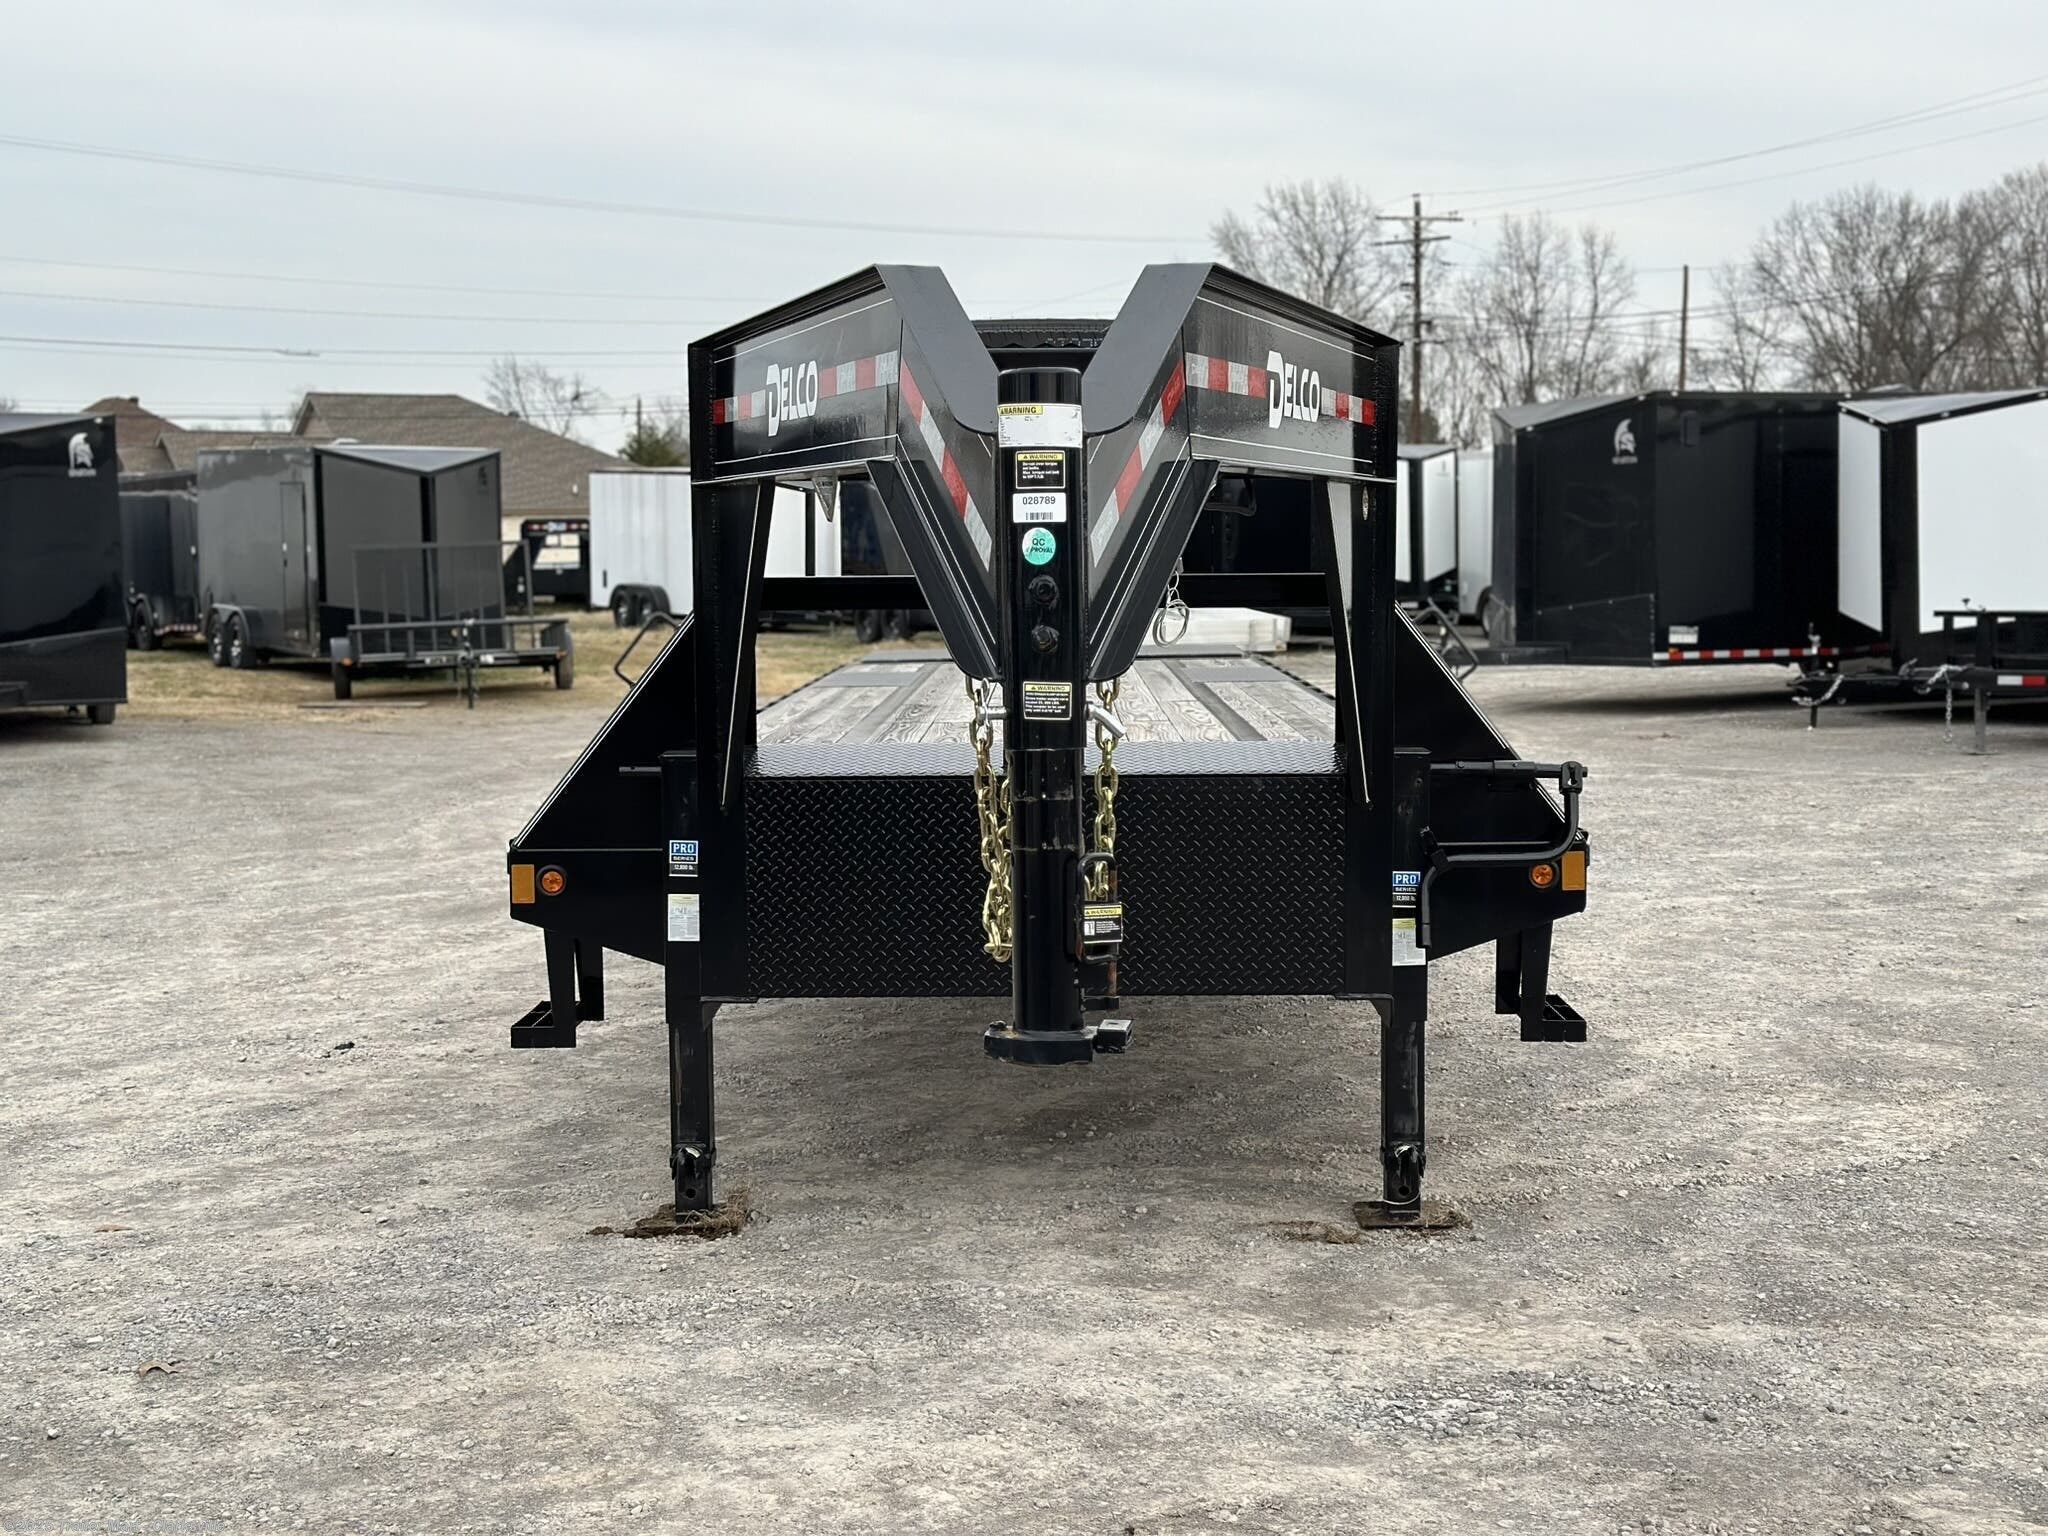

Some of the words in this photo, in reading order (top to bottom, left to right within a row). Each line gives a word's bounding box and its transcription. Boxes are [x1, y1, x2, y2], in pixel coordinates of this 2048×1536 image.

[1266, 350, 1320, 429] DELCO
[766, 360, 818, 437] DELCO
[1004, 406, 1037, 414] WARNING
[1022, 496, 1056, 504] 028789
[1032, 538, 1045, 546] QC
[673, 843, 695, 853] PRO
[1395, 874, 1416, 884] PRO
